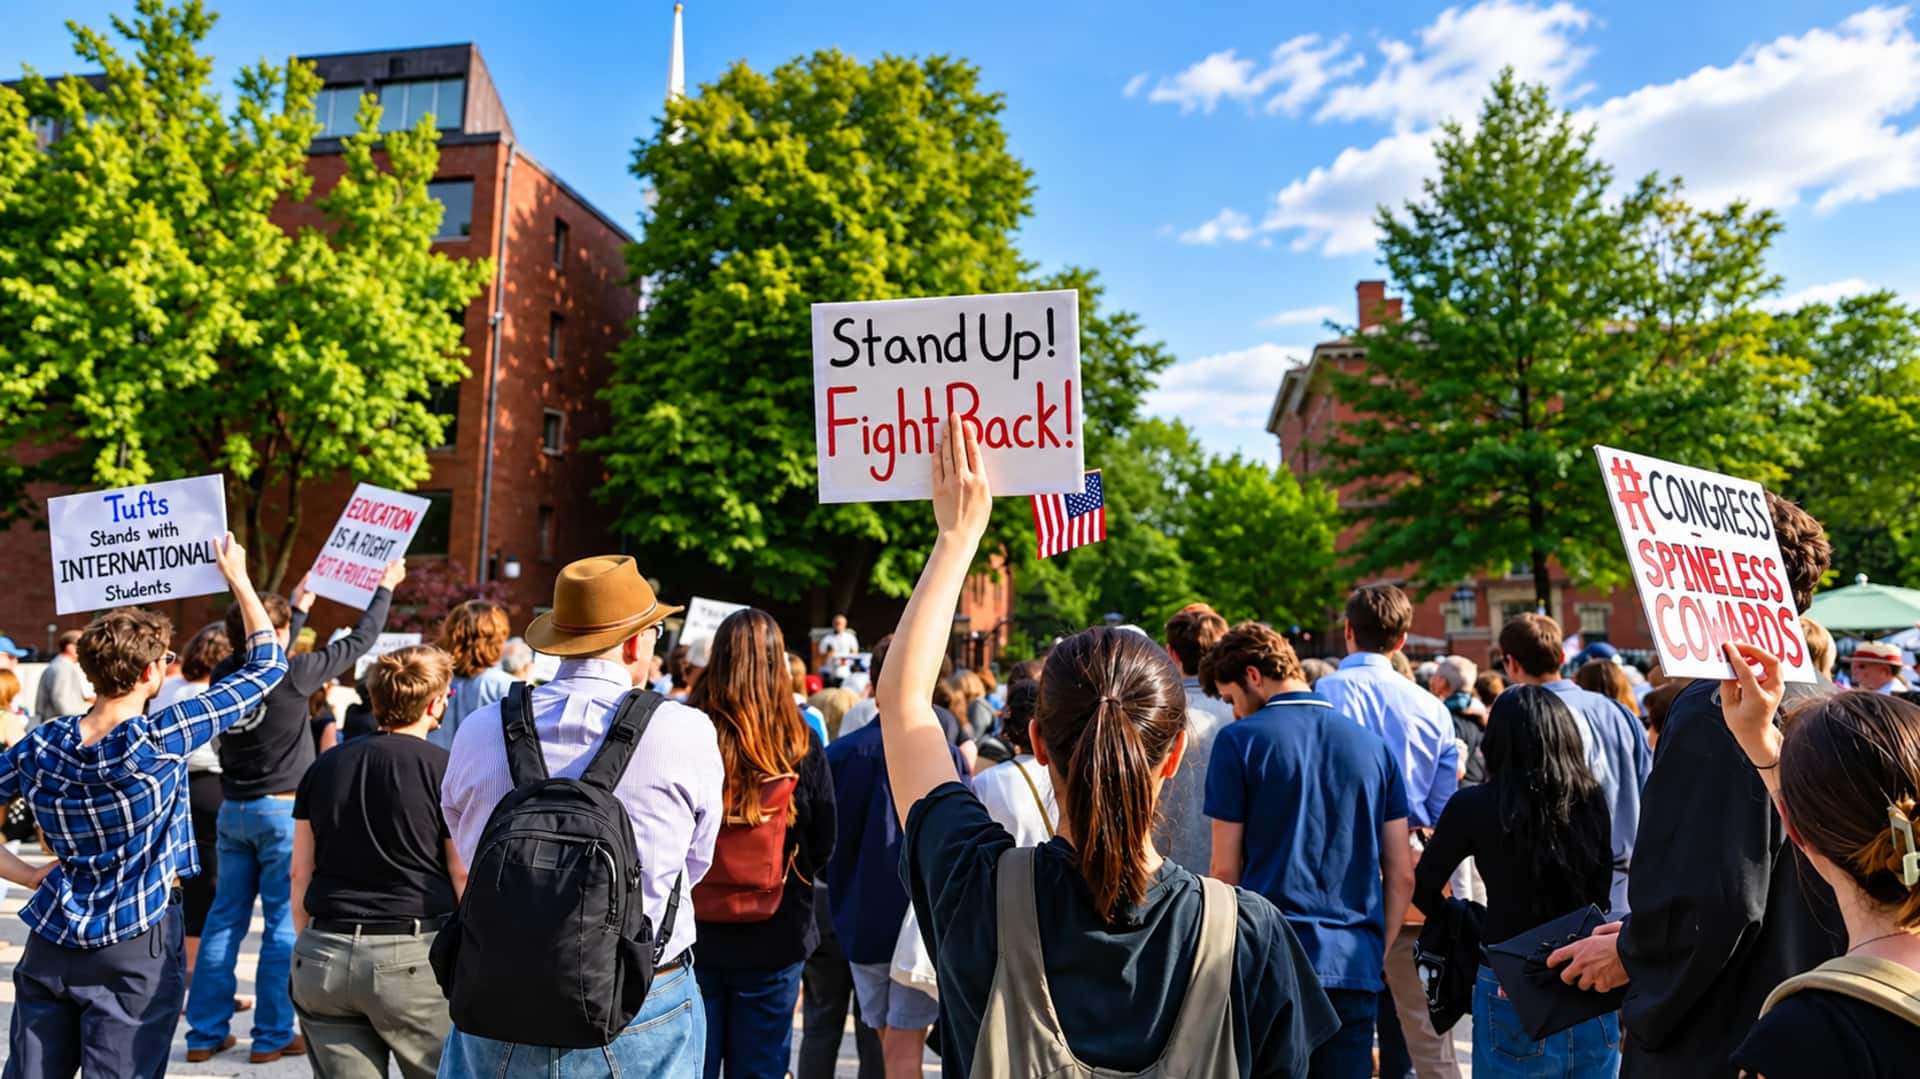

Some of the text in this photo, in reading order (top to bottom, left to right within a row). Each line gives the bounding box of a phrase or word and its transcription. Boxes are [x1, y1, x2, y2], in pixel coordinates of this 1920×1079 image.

[829, 307, 1056, 379] Stand Up!
[826, 379, 1075, 482] Fight Back!
[103, 490, 169, 523] Tufts
[345, 497, 418, 533] EDUCATION
[1611, 457, 1771, 541] #CONGRESS
[90, 521, 179, 548] Stands with
[330, 526, 397, 561] IS A RIGHT
[60, 541, 216, 583] INTERNATIONAL
[1638, 538, 1784, 603] SPINELESS
[105, 580, 172, 602] Students
[1655, 593, 1804, 668] COWARDS
